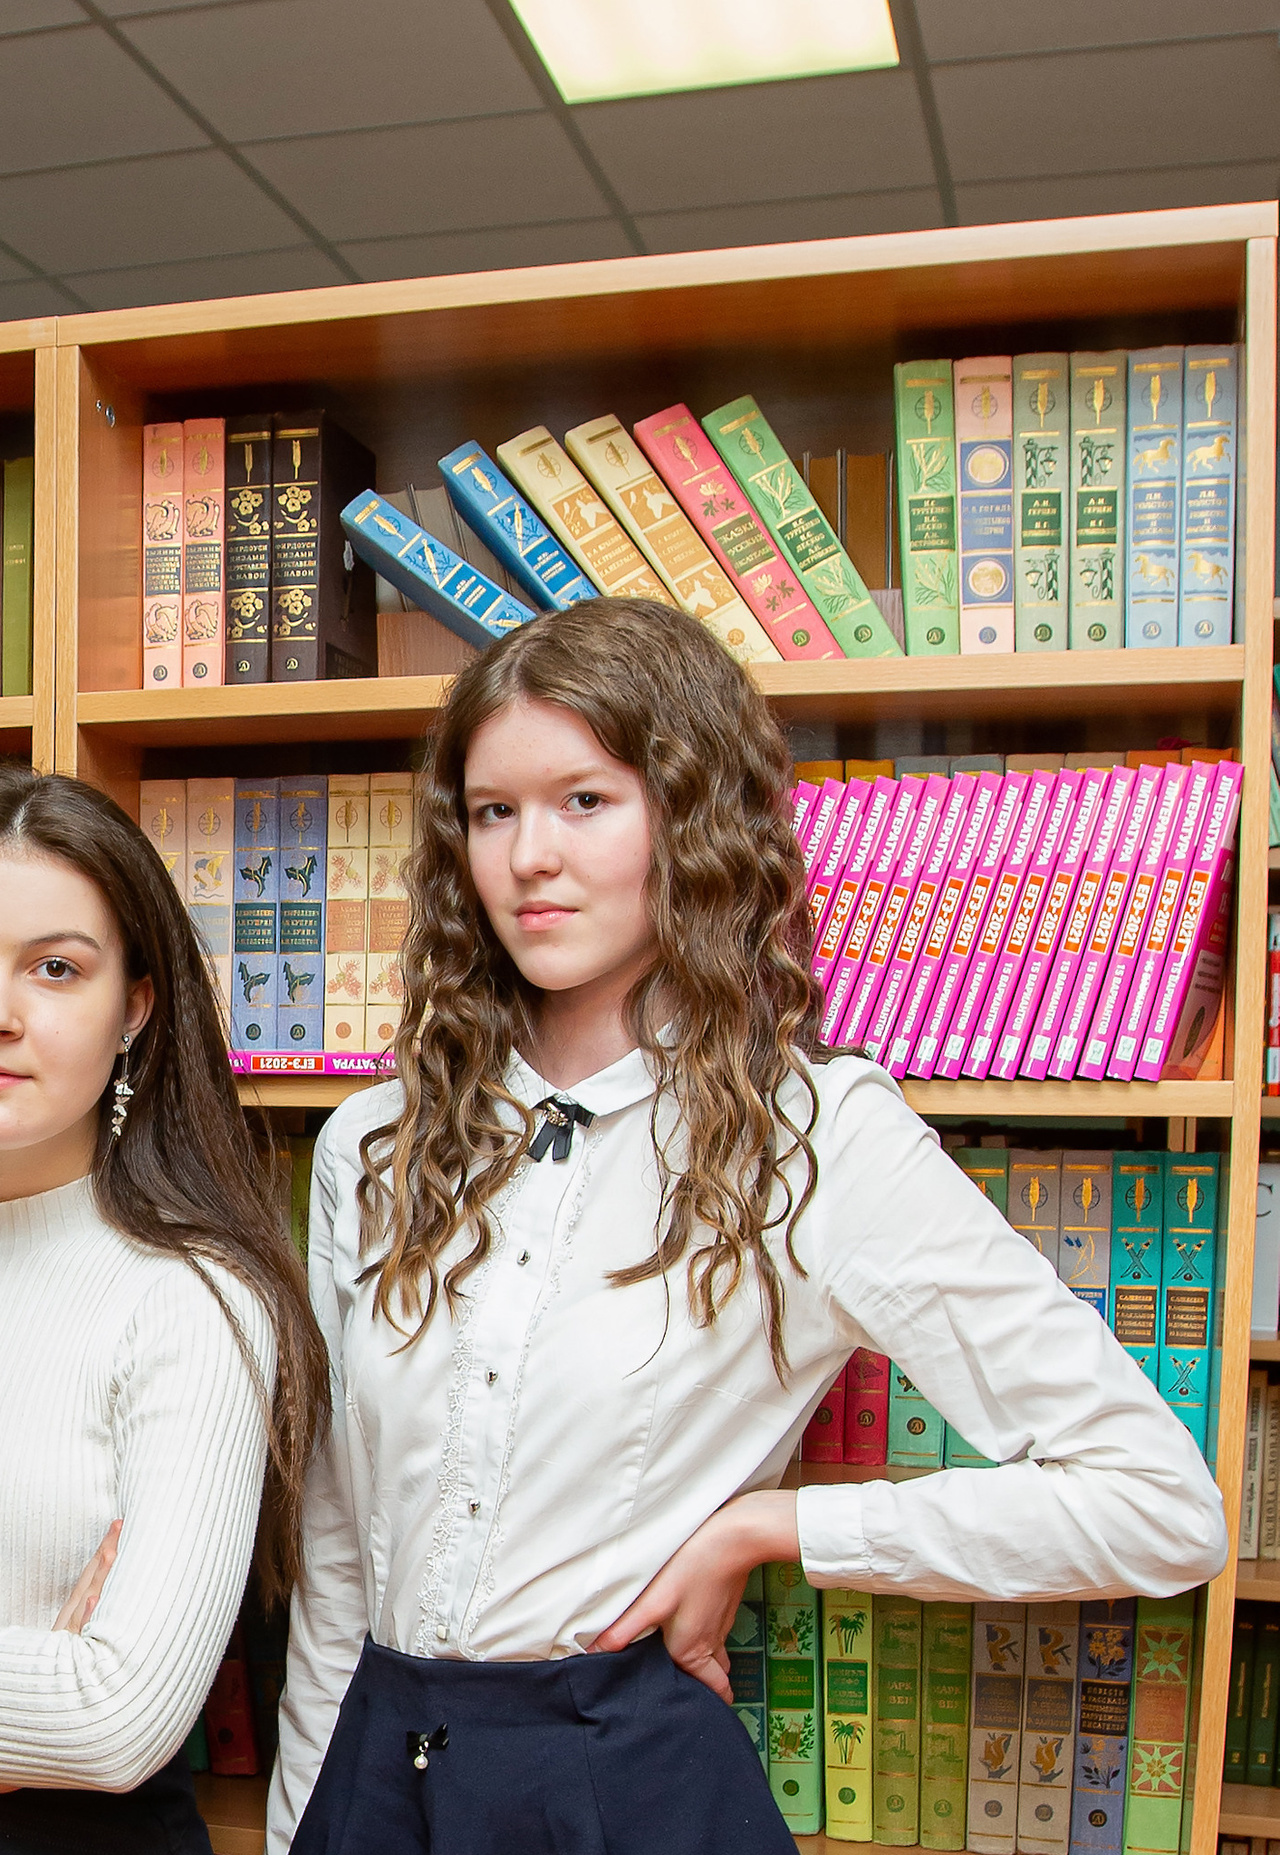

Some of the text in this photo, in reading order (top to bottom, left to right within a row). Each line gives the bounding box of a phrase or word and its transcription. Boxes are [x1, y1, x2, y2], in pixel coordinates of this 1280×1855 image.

[815, 792, 887, 977] ЛИТЕРАТУРА ЕГЭ-2021 15
[823, 796, 860, 877] ЛИТЕРАТУРА
[866, 796, 937, 984] ЛИТЕРАТУРА ЕГЭ-2021 15
[876, 791, 913, 873] ЛИТЕРАТУРА
[903, 787, 992, 1034] ЛИТЕРАТУРА ЕГЭ-2021 15 ВАРИАНТОВ
[929, 784, 1019, 1032] ЛИТЕРАТУРА ЕГЭ-2021 15 ВАРИАНТОВ
[957, 782, 1047, 1031] ЛИТЕРАТУРА ЕГЭ-2021 15 ВАРИАНТОВ
[984, 783, 1072, 1032] ЛИТЕРАТУРА ЕГЭ-2021 15 ВАРИАНТОВ
[1012, 780, 1099, 1031] ЛИТЕРАТУРА ЕГЭ-2021 15 ВАРИАНТОВ
[1043, 778, 1127, 1030] ЛИТЕРАТУРА ЕГЭ-2021 15 ВАРИАНТОВ
[1069, 777, 1154, 1031] ЛИТЕРАТУРА ЕГЭ-2021 15 ВАРИАНТОВ
[1098, 780, 1180, 1034] ЛИТЕРАТУРА ЕГЭ-2021 15 ВАРИАНТОВ
[1173, 774, 1207, 861] ЛИТЕРАТУРА
[1200, 775, 1233, 862] ЛИТЕРАТУРА
[840, 967, 851, 978] 15
[849, 890, 879, 950] ЕГЭ-2021
[874, 792, 964, 1037] ЛИТЕРАТУРА ЕГЭ-2021 15 ВАРИАНТОВ
[1151, 879, 1178, 943] ЕГЭ-2021
[1178, 881, 1206, 944] ЕГЭ-2021
[260, 1058, 315, 1069] ЕГЭ-2021
